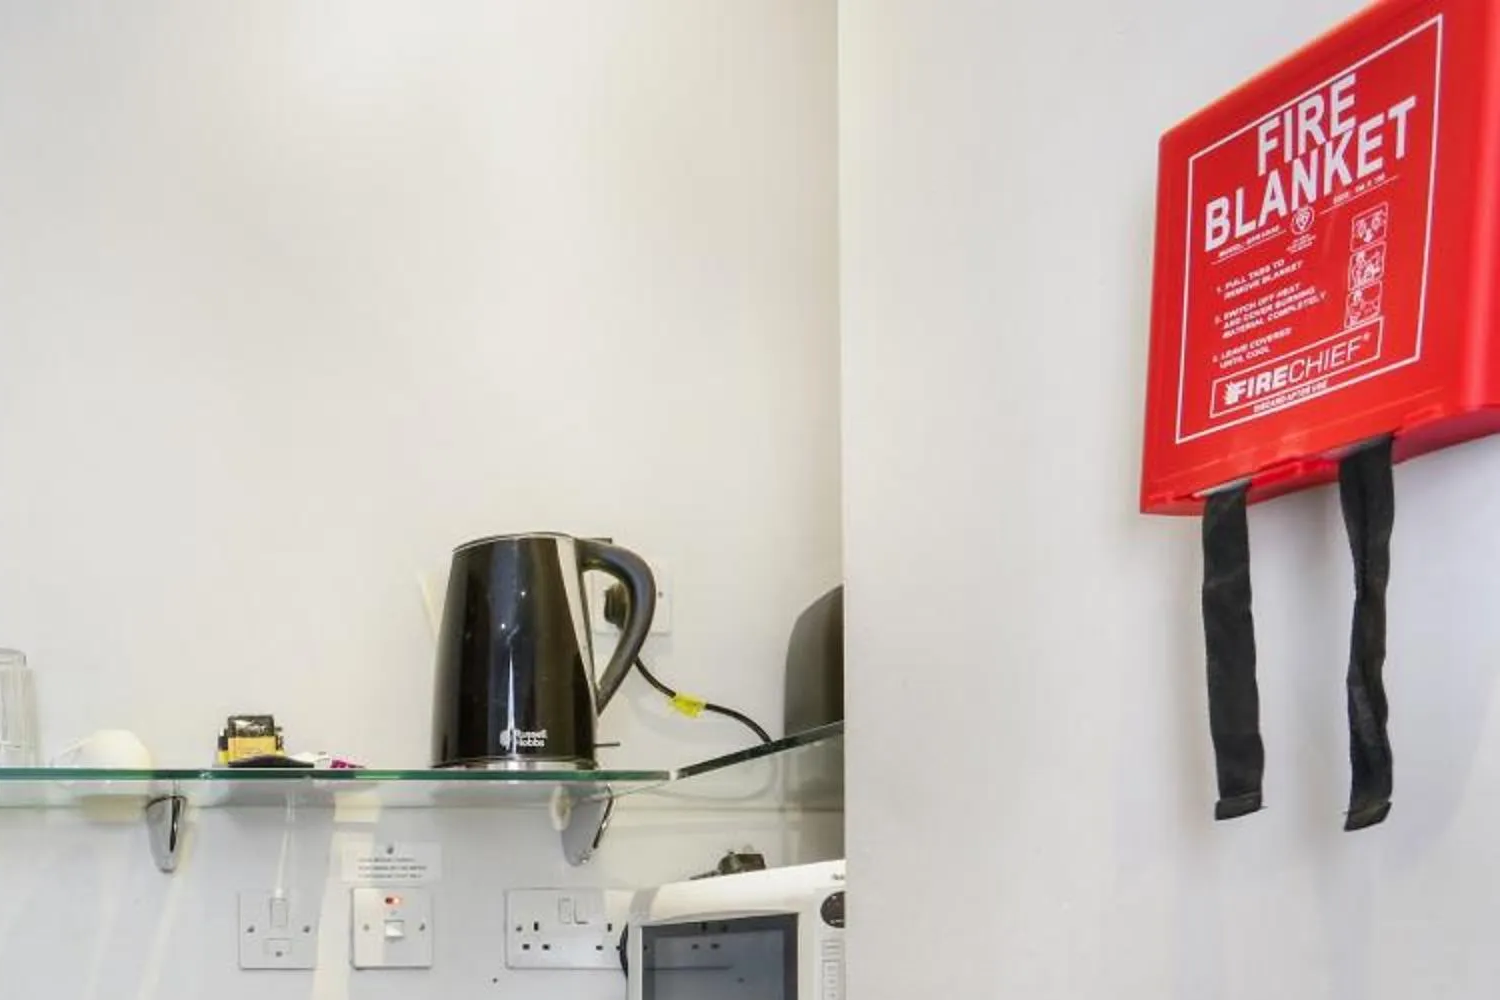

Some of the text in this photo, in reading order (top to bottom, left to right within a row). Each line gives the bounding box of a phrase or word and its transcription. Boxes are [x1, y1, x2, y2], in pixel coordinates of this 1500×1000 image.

[1204, 95, 1417, 253] BLANKET
[1258, 73, 1357, 177] FIRE
[1273, 259, 1285, 269] TO
